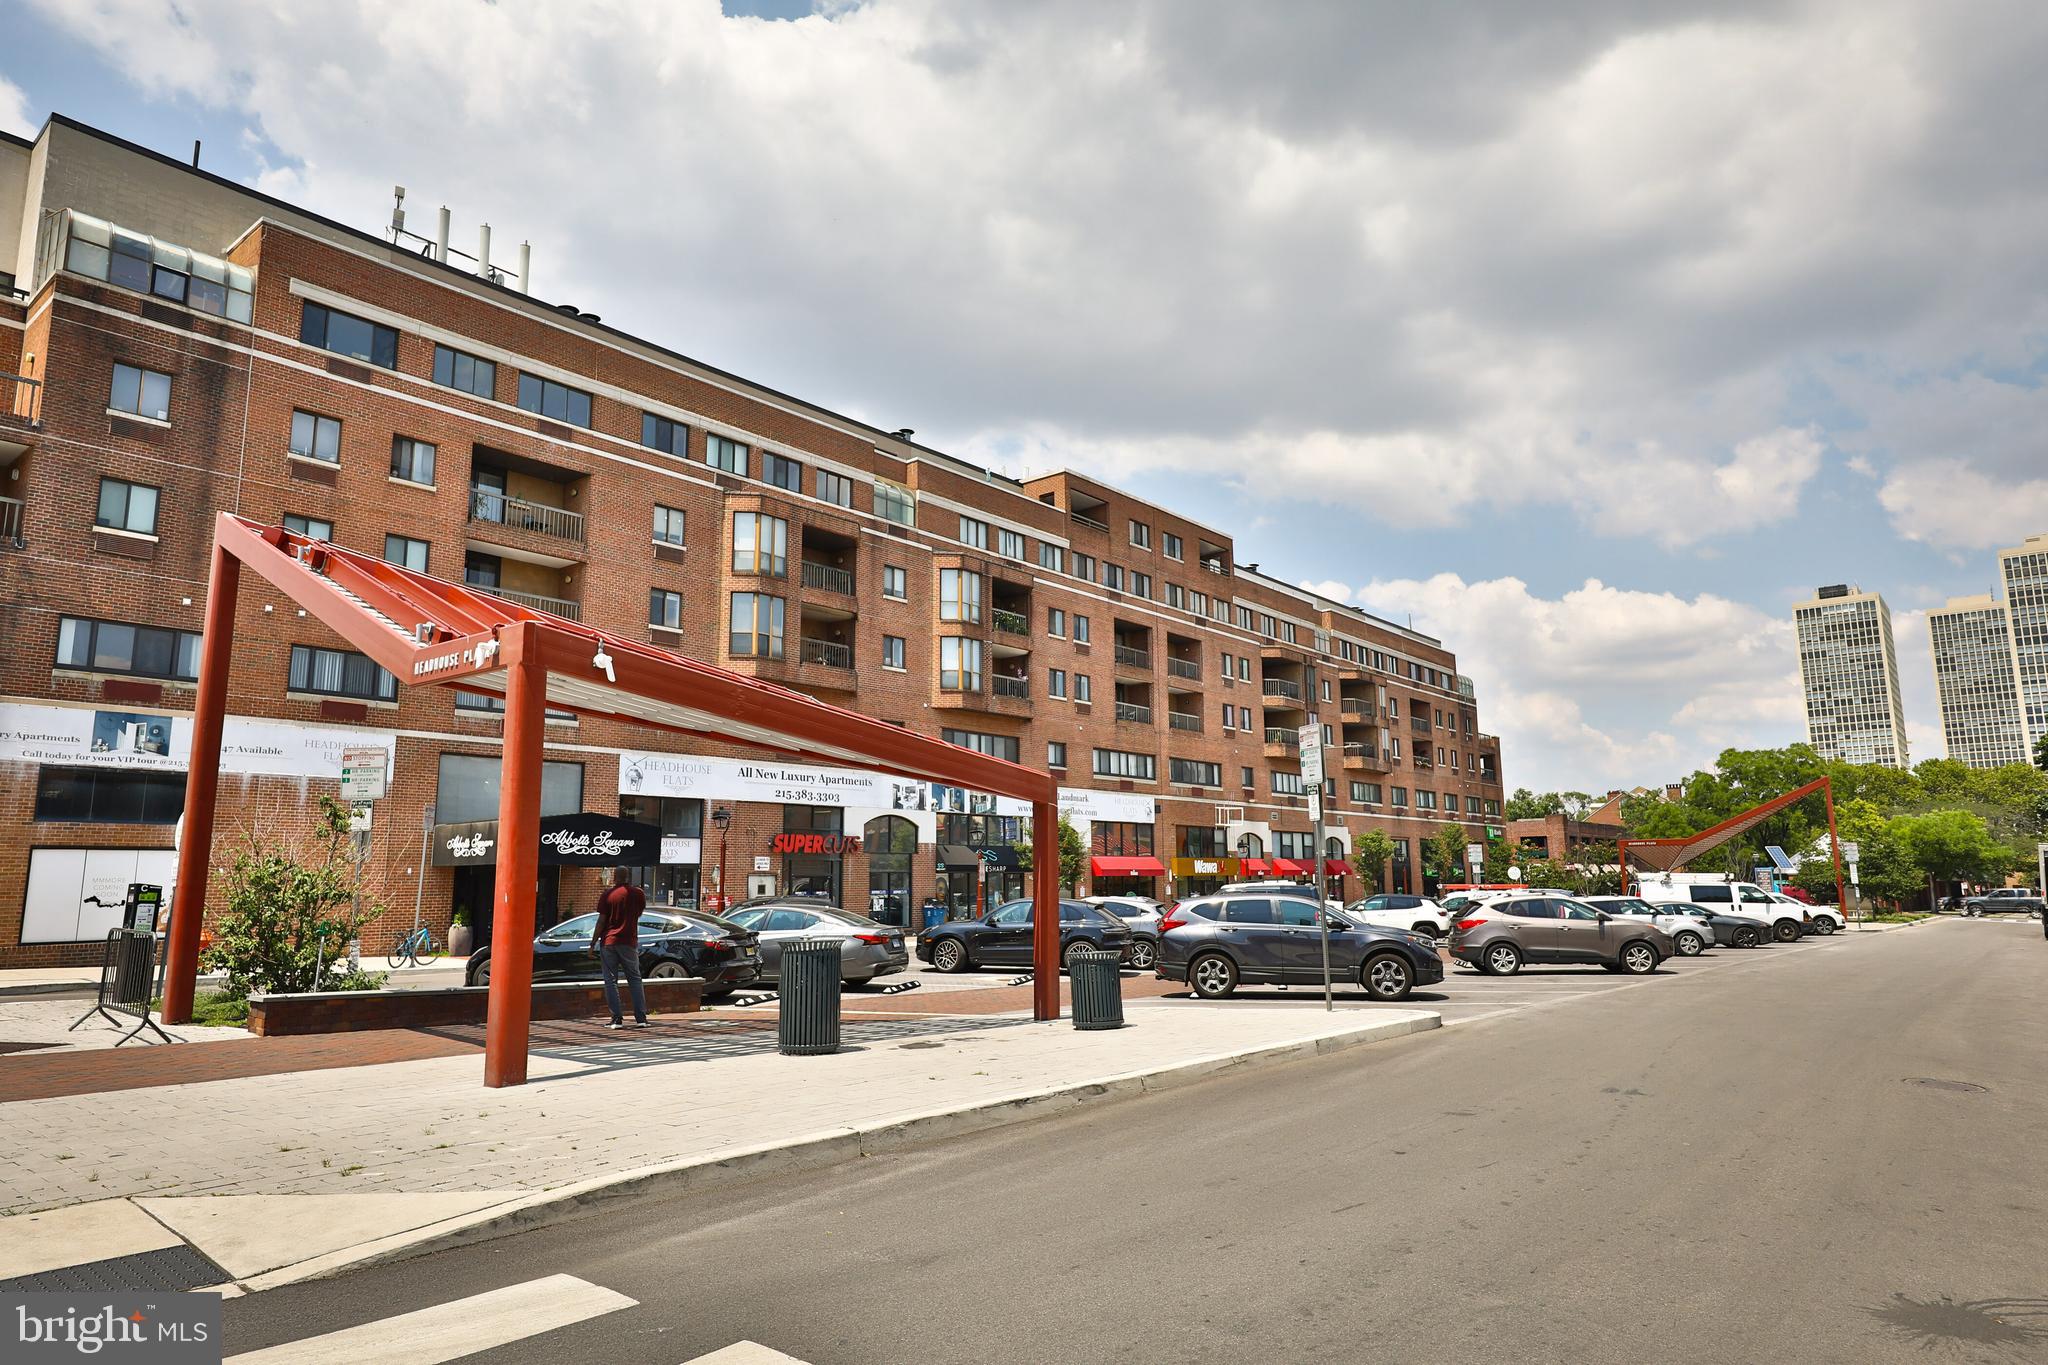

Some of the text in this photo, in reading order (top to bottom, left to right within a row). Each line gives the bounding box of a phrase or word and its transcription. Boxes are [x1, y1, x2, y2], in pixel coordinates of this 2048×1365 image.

[14, 732, 81, 743] Apartments
[22, 750, 42, 758] Call
[45, 752, 73, 761] today
[75, 753, 91, 761] for
[92, 756, 116, 764] your
[117, 756, 136, 764] VIP
[137, 757, 158, 765] tour
[236, 745, 284, 756] Available
[644, 760, 713, 775] HEADHOUSE
[663, 774, 694, 786] FLATS
[737, 767, 873, 787] All New Luxury Apartments
[775, 789, 840, 803] 215.383.3303
[593, 831, 635, 850] Square
[772, 834, 861, 853] SUPERCUTS
[1194, 859, 1218, 874] Wawa
